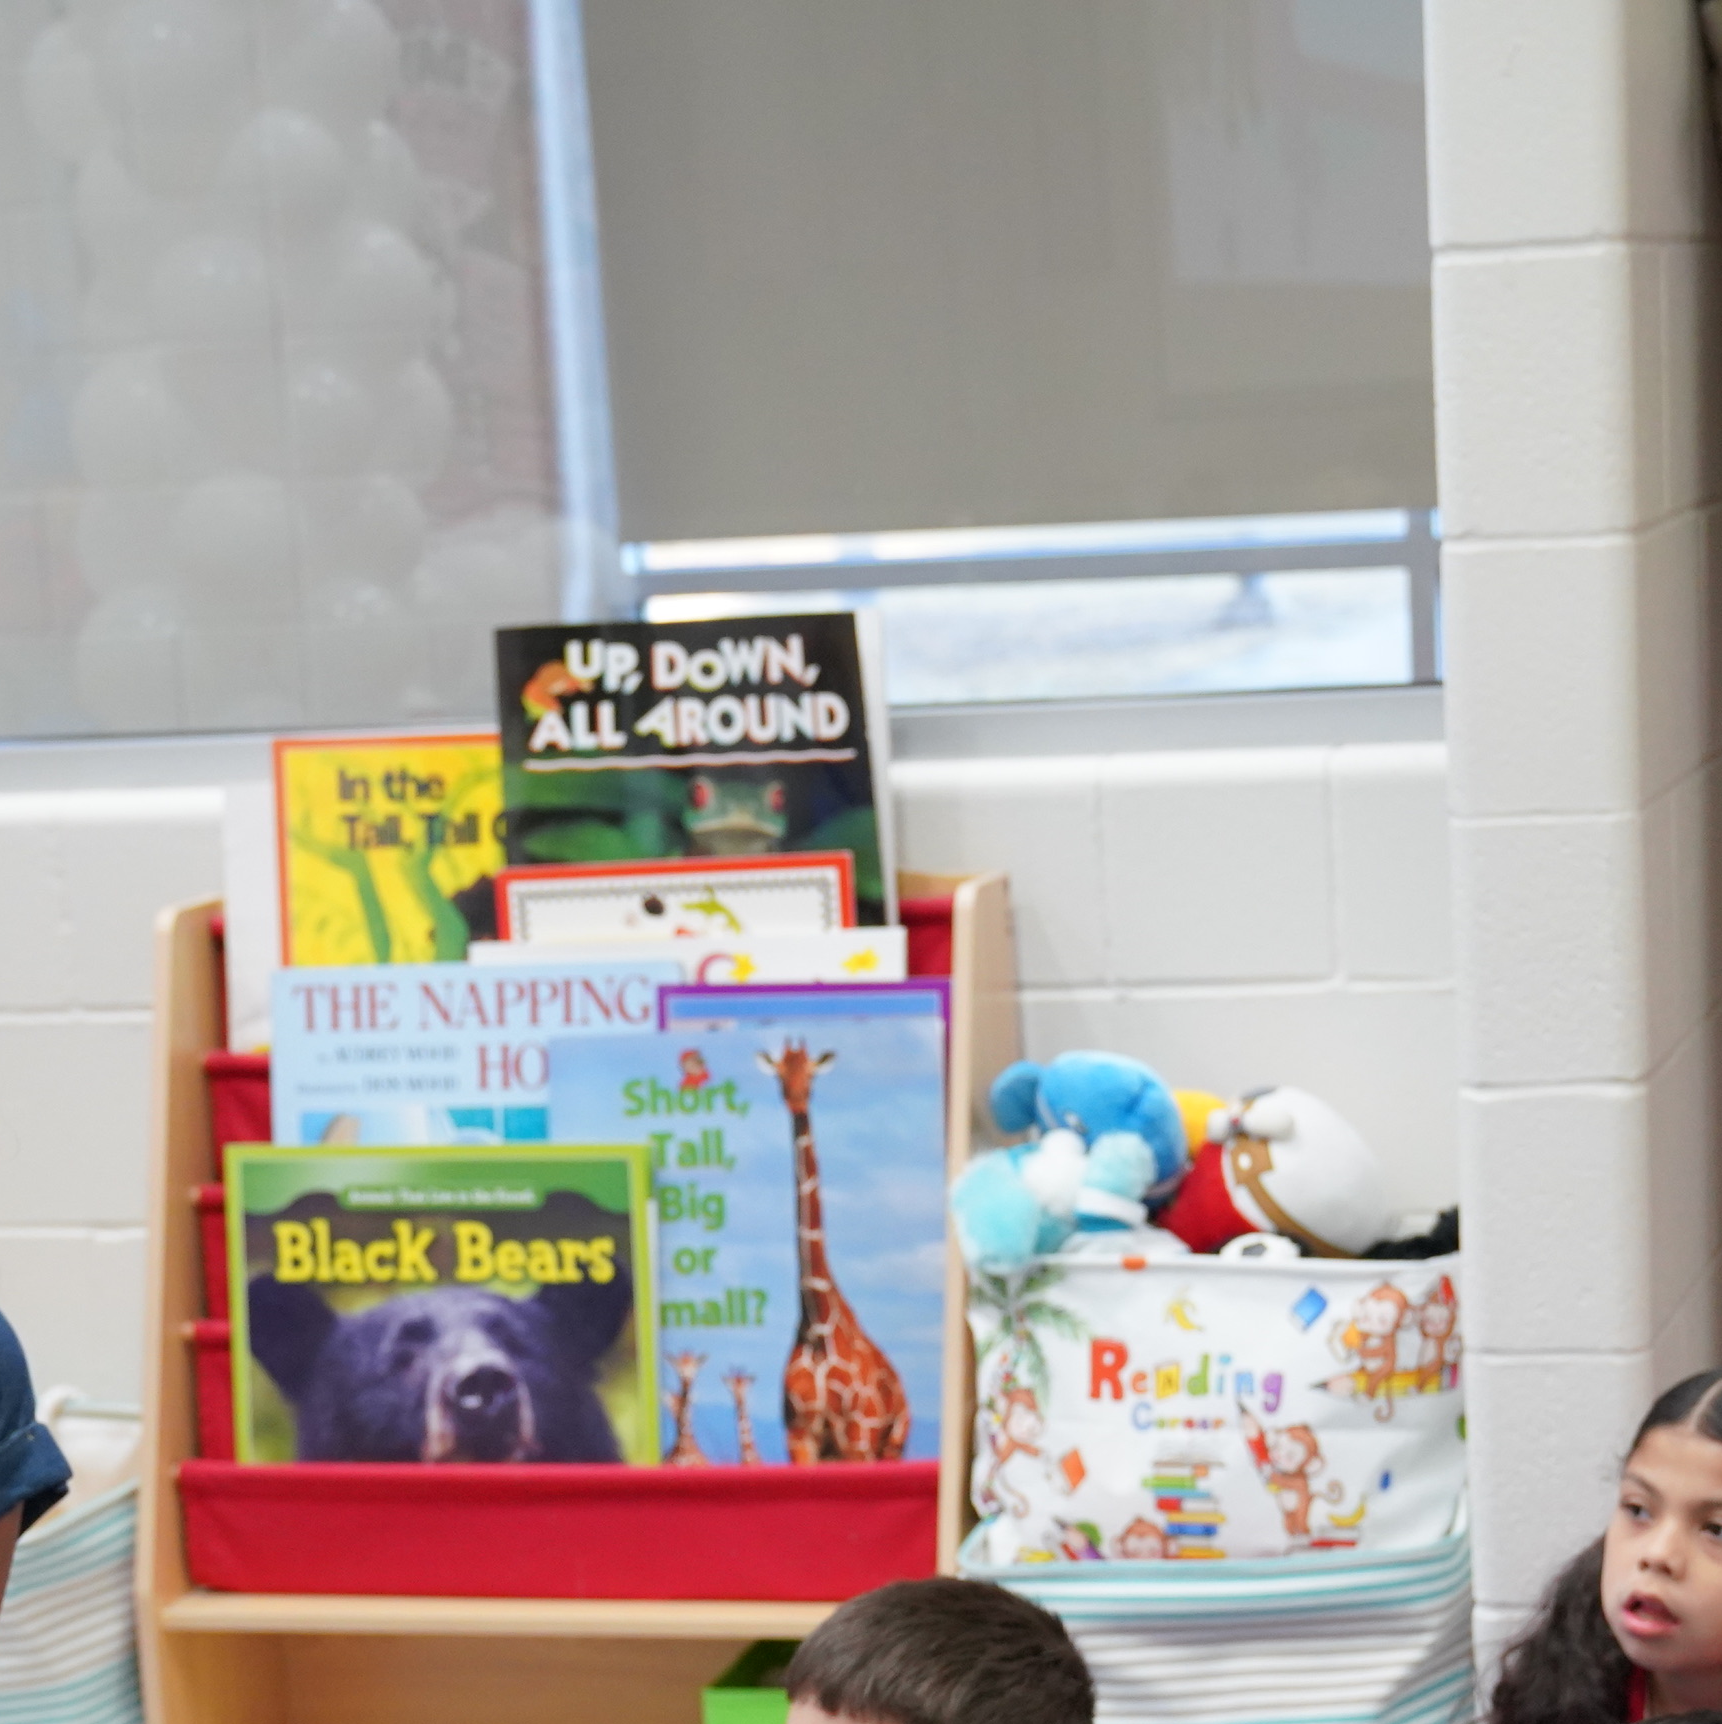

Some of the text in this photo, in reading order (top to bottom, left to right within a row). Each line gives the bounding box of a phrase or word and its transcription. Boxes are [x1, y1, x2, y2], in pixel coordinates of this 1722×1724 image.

[563, 633, 822, 695] UP, DOWN,
[528, 691, 852, 754] ALL AROUND
[338, 766, 445, 801] In the
[341, 813, 414, 854] Tall,
[418, 811, 480, 846] Tall
[291, 973, 652, 1033] THE NAPPING
[476, 1041, 550, 1092] HO
[622, 1077, 751, 1119] Short,
[646, 1127, 736, 1171] Tall,
[658, 1182, 726, 1231] Big
[272, 1215, 617, 1284] Black Bears
[672, 1246, 719, 1275] or
[660, 1286, 768, 1329] mall?
[1088, 1337, 1285, 1413] Reading
[1131, 1401, 1225, 1431] Corner
